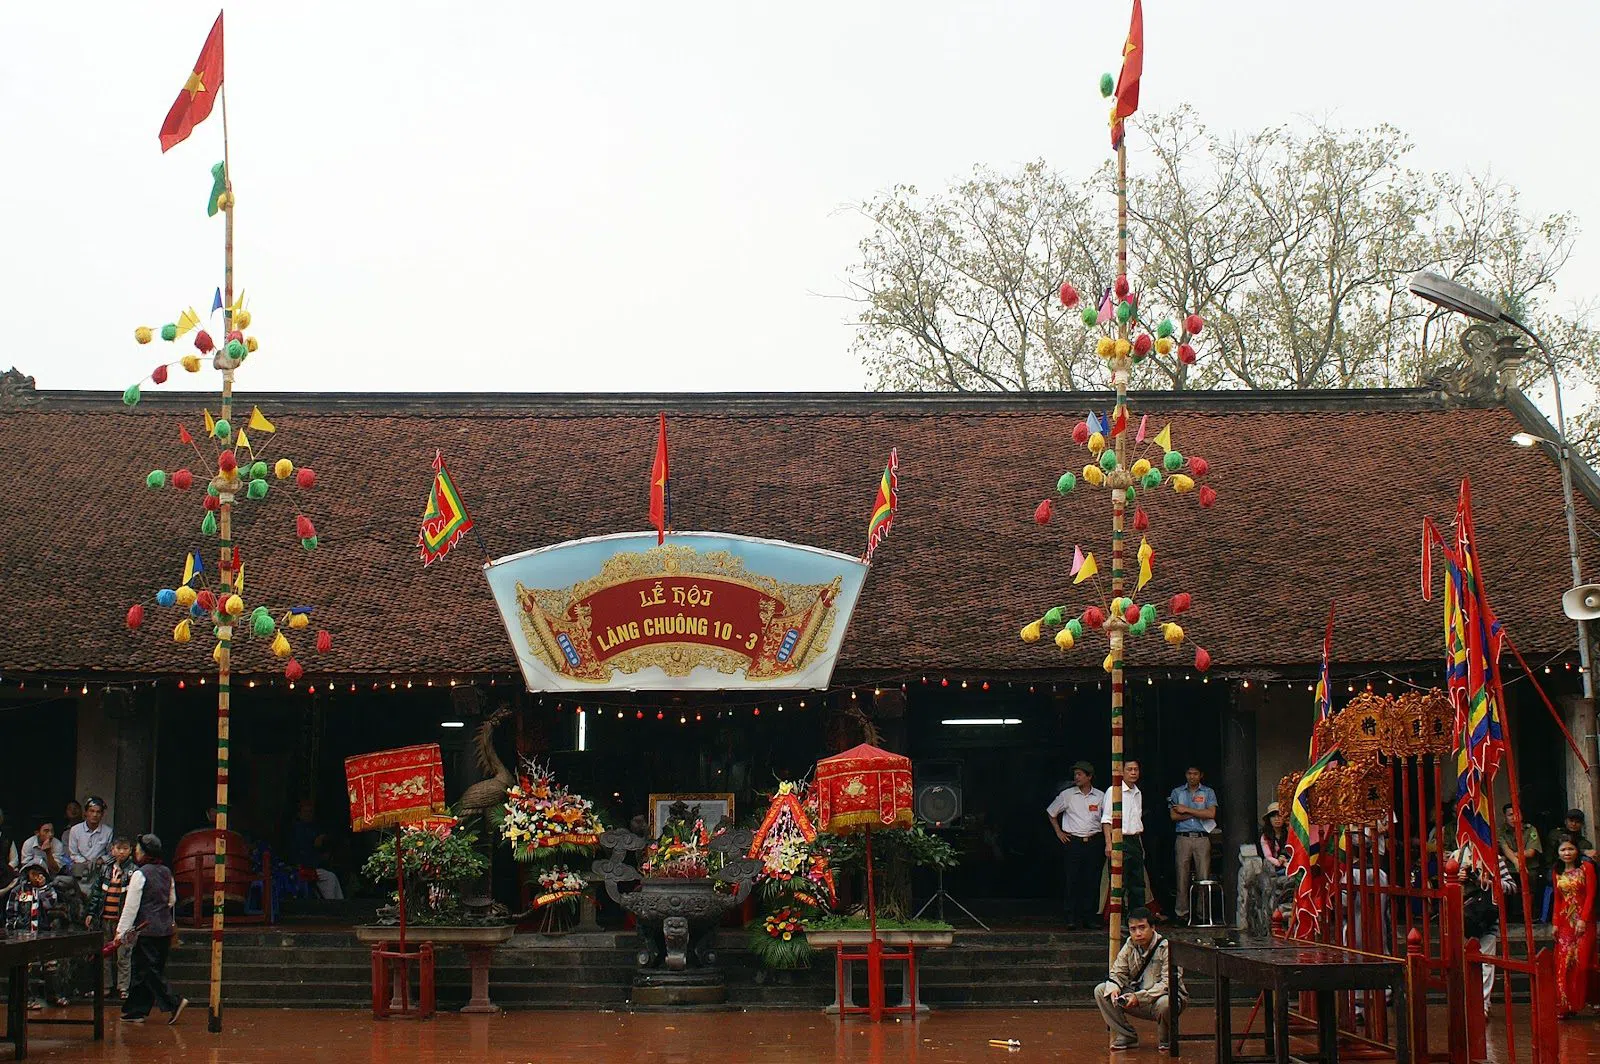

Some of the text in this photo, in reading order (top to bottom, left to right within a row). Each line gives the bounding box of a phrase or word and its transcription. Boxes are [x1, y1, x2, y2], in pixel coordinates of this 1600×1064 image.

[639, 581, 666, 607] LỄ
[596, 621, 640, 651] LÀNG
[643, 613, 708, 636] CHUÔNG
[713, 620, 733, 641] 10
[745, 633, 759, 650] 3
